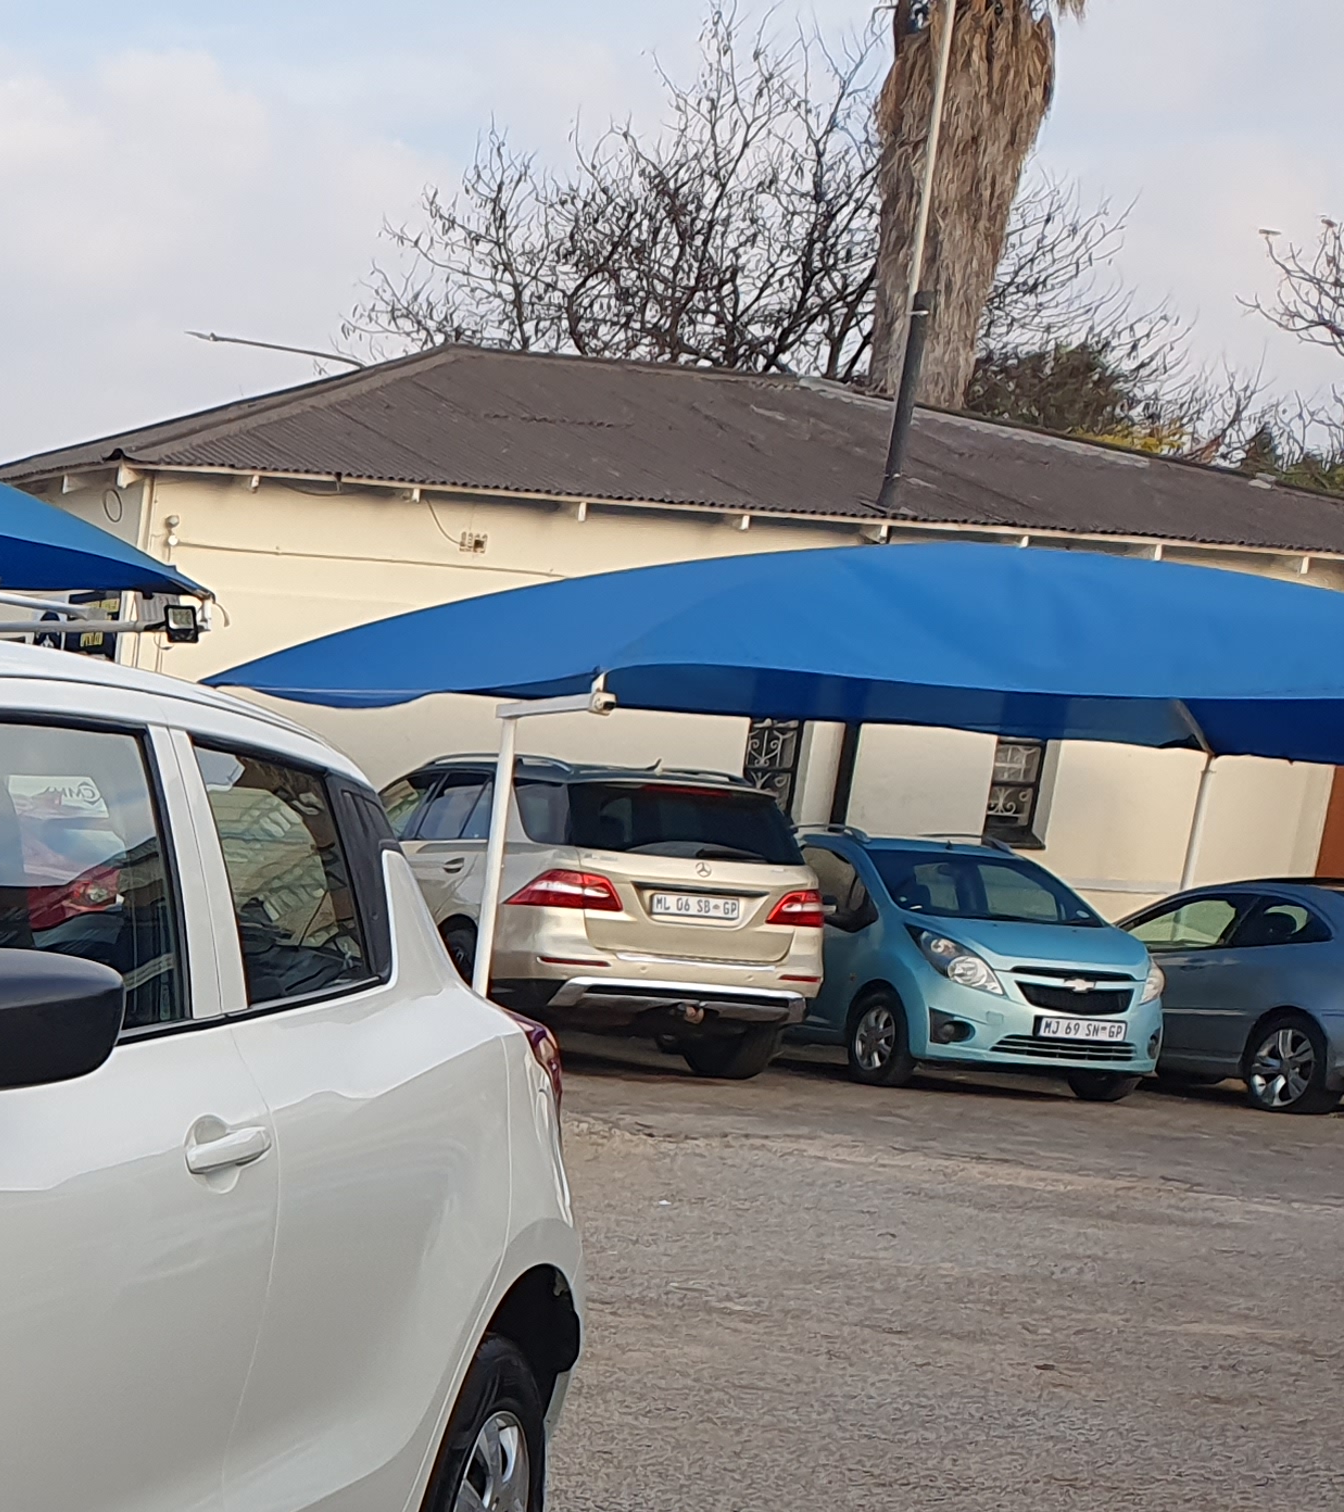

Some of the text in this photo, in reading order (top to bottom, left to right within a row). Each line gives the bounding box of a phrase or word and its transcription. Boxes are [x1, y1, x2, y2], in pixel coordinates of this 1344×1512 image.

[656, 897, 738, 915] ML 06 SB GP
[1043, 1020, 1123, 1038] MJ 69 SN GP
